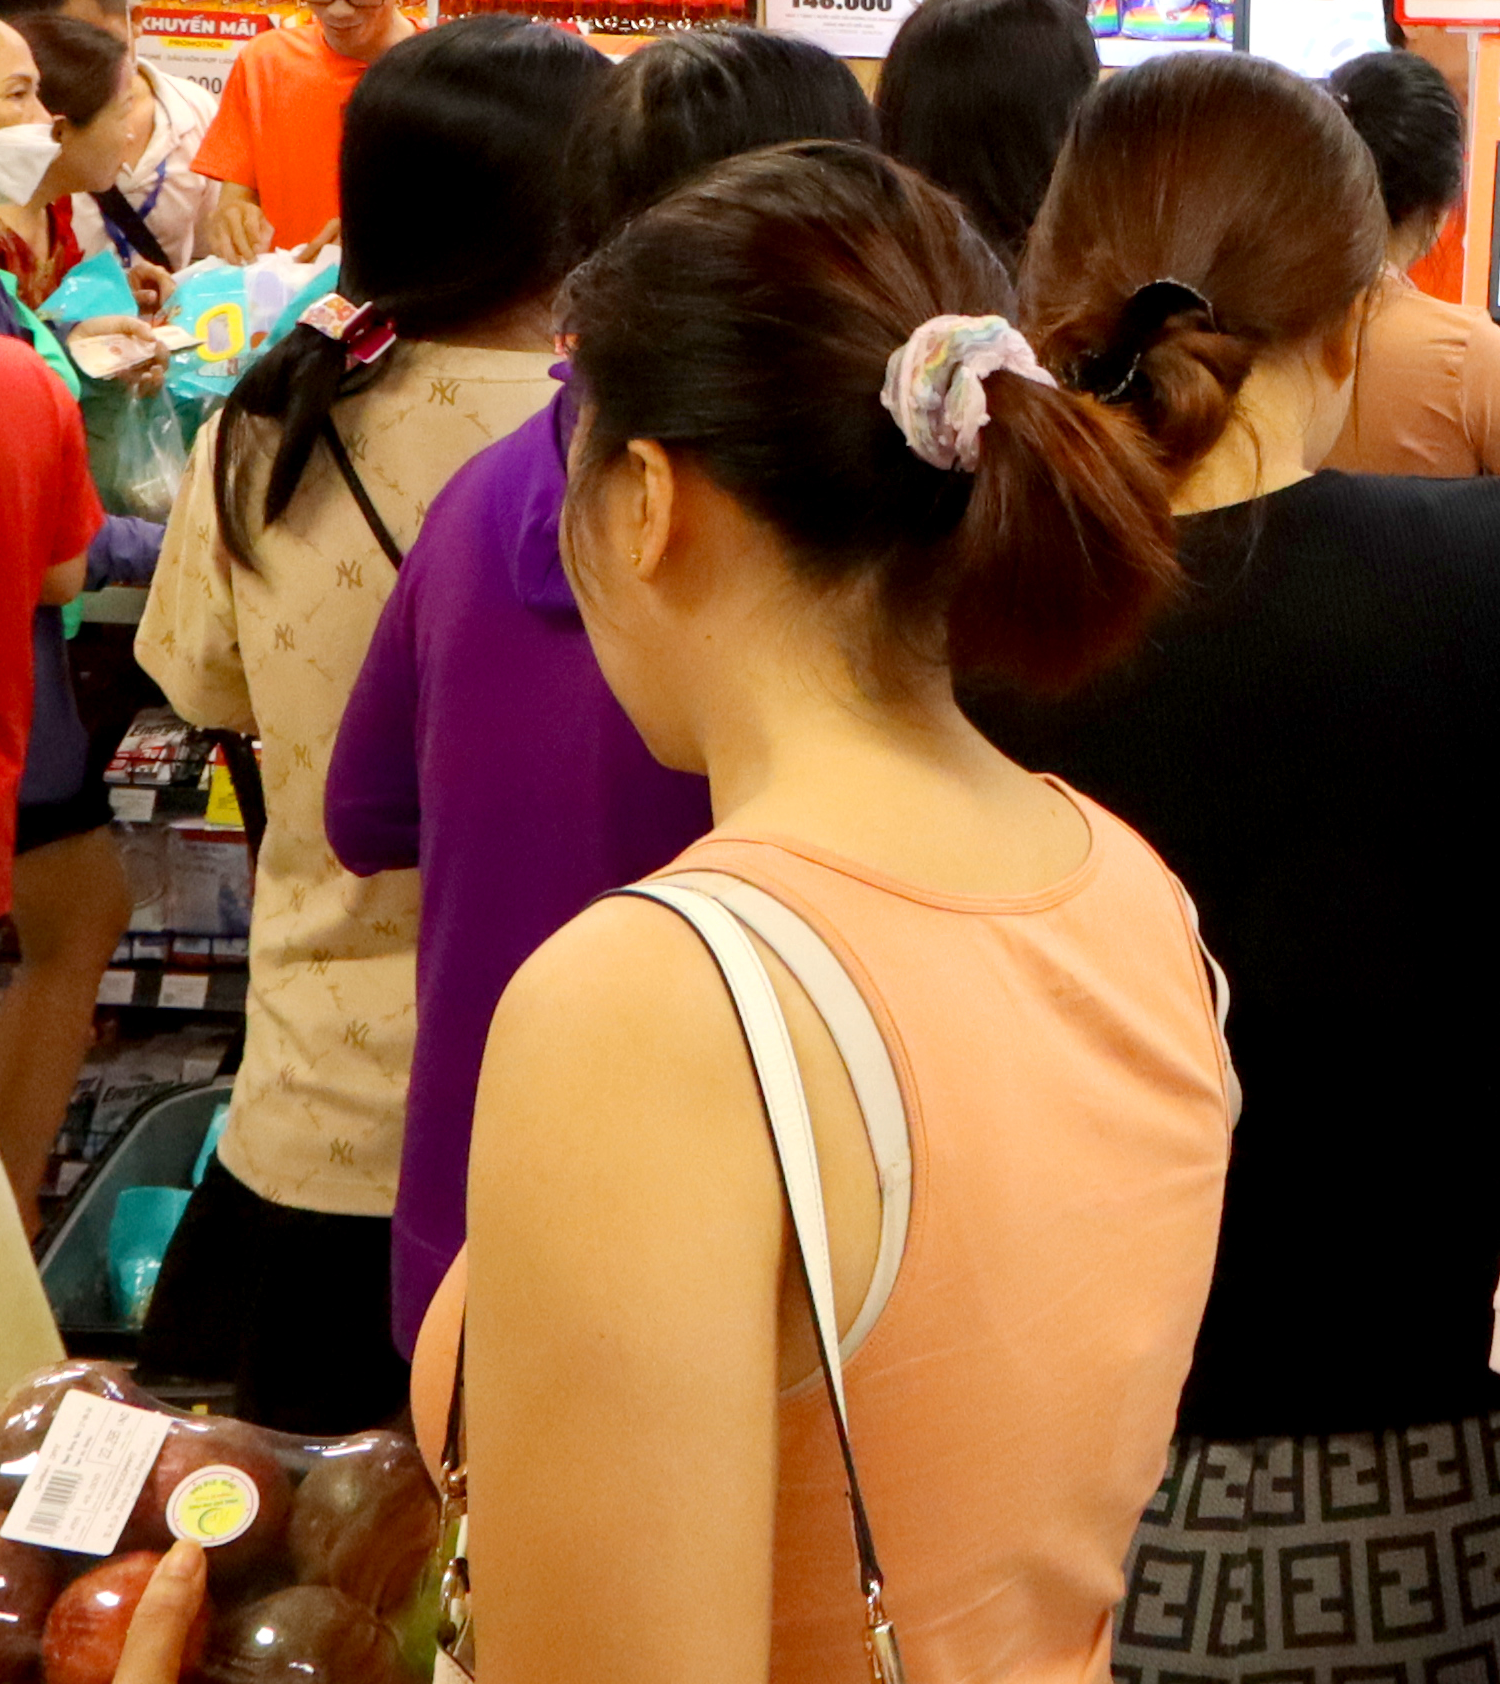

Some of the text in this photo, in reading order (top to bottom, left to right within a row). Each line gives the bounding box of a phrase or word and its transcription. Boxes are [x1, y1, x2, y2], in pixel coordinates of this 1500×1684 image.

[141, 14, 257, 37] KHUYẾN MÃI
[168, 39, 225, 49] PROMOTION
